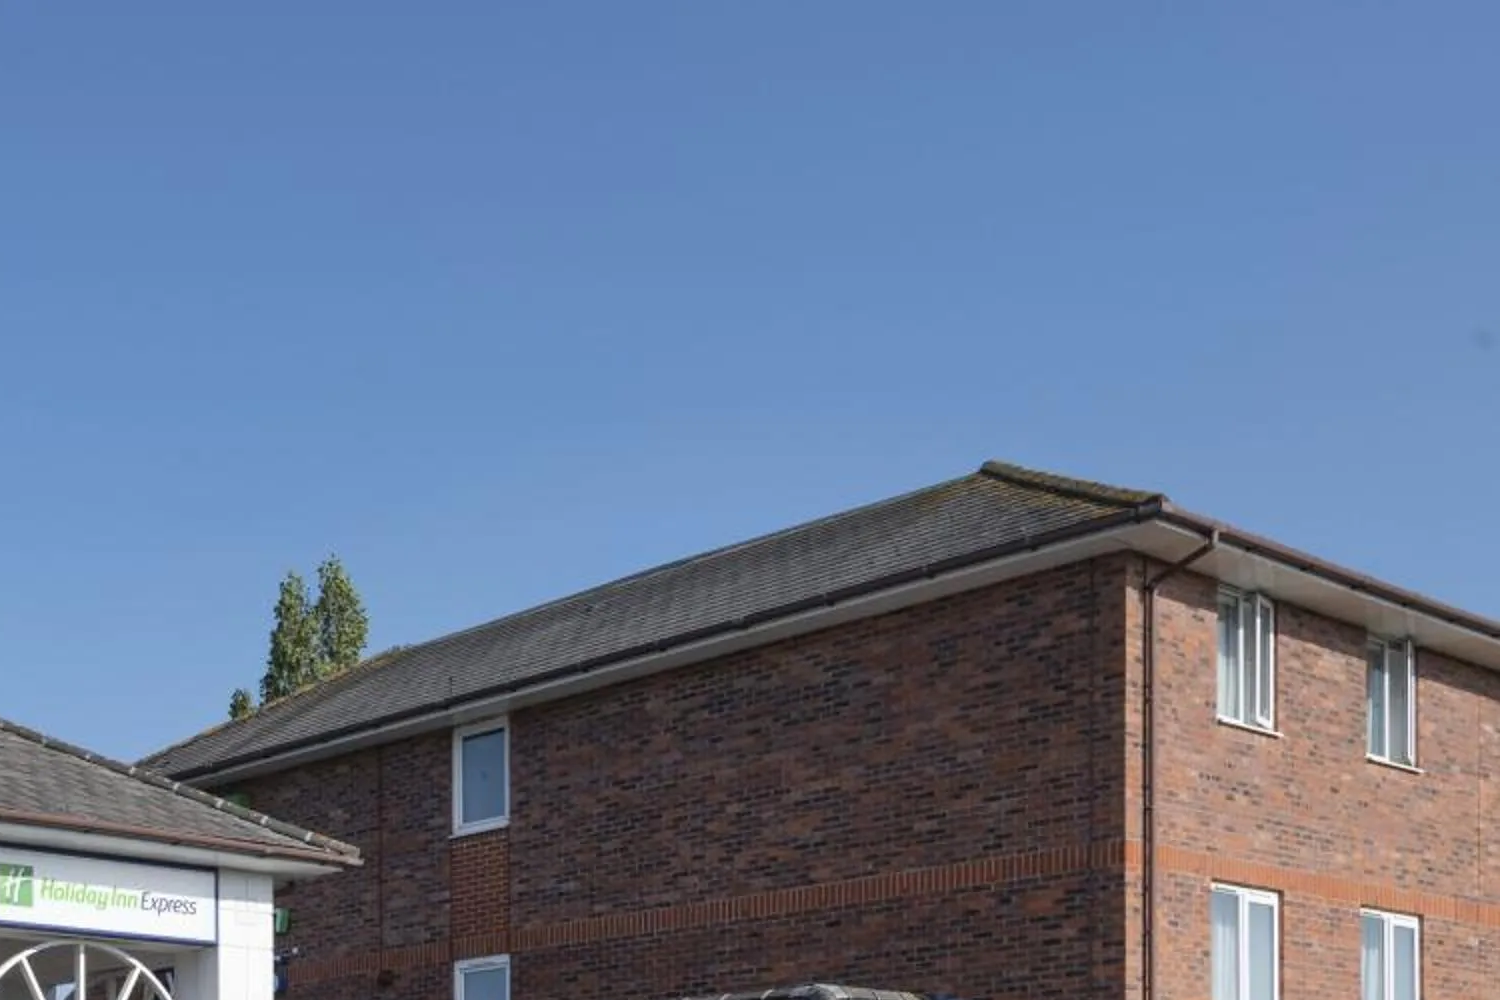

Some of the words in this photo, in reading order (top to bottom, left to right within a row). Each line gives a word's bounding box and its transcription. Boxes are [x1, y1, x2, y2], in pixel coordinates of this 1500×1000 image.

[41, 877, 108, 910] Holiday
[111, 885, 137, 909] Inn
[141, 892, 197, 916] Express
